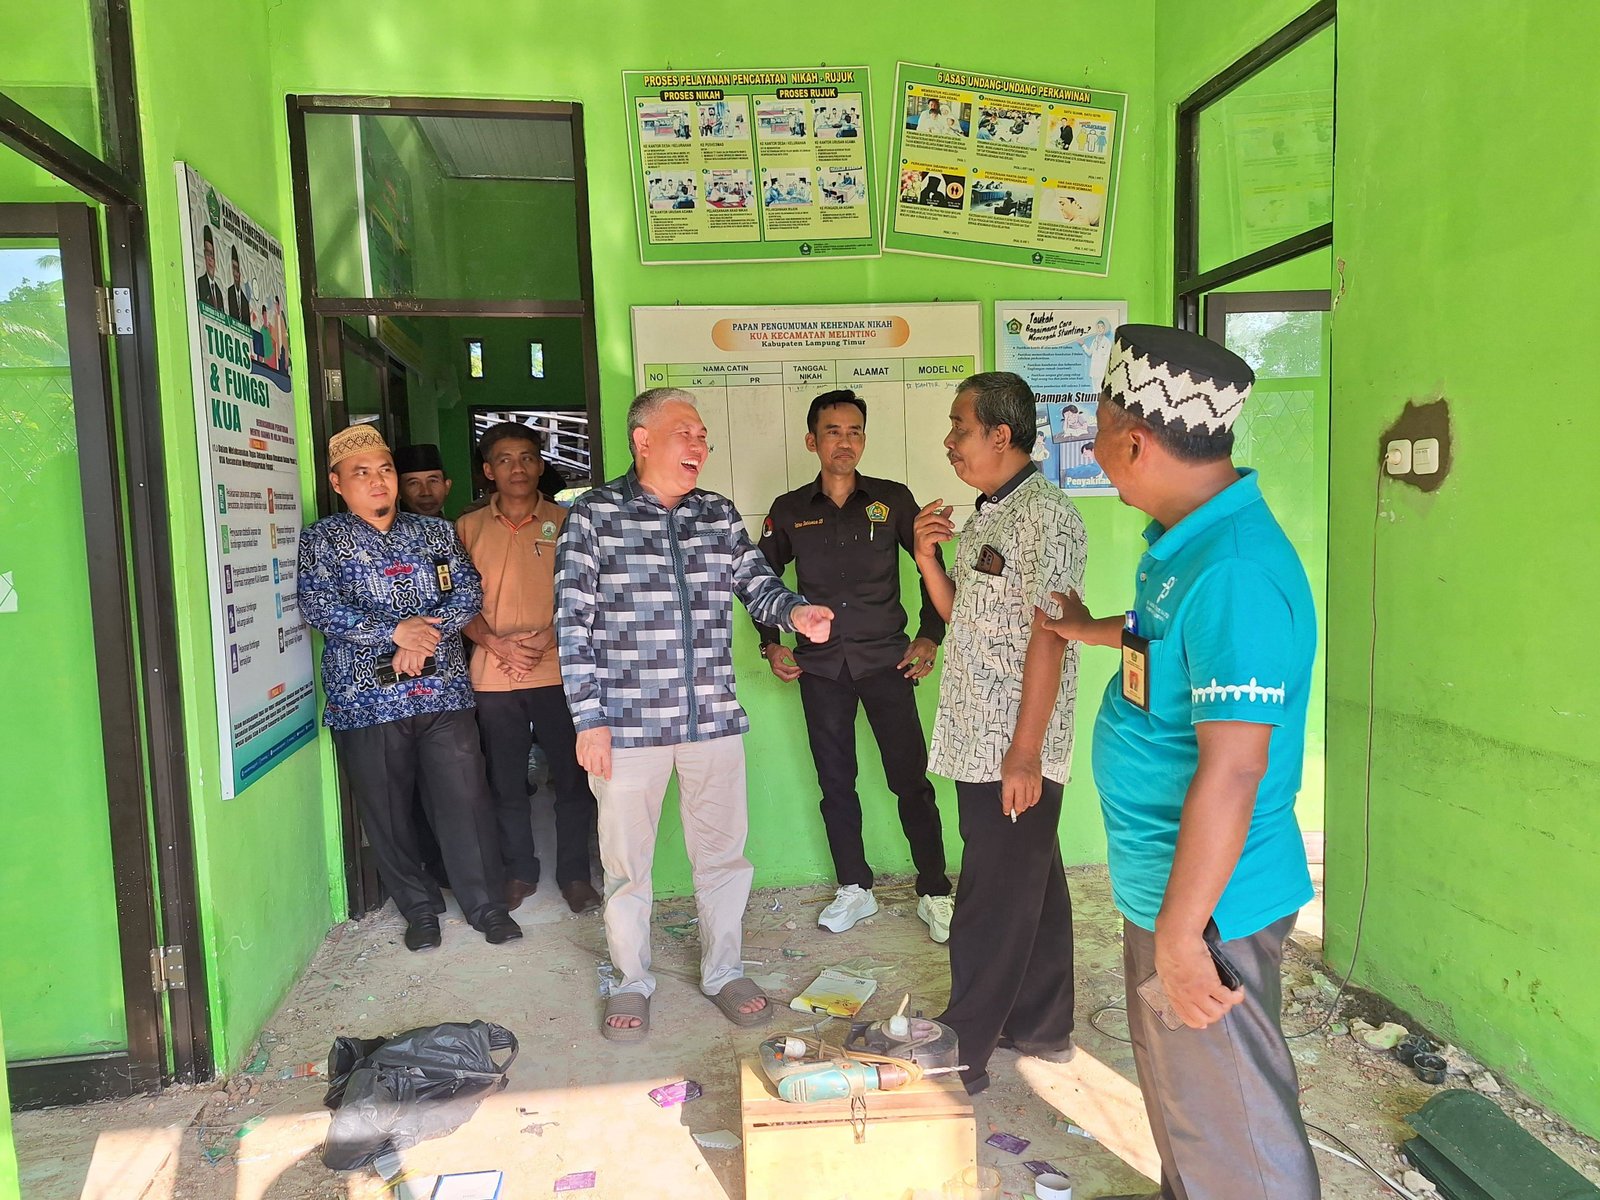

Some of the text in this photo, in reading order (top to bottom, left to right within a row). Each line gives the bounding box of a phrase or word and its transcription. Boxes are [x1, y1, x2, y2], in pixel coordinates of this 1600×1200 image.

[644, 75, 679, 87] PROSES
[680, 74, 731, 86] PELAYANAN
[732, 73, 787, 85] PENCATATAN
[792, 72, 818, 84] NIKAH
[825, 72, 854, 83] RUJUK
[938, 72, 1091, 103] 6 ASAS UNDANG-UNDANG PERKAWINAN
[664, 91, 720, 100] PROSES NIKAH
[780, 88, 836, 98] PROSES RUJUK
[1026, 324, 1058, 334] Bagaimana
[771, 331, 826, 339] KECAMATAN
[829, 330, 876, 338] MELINTING
[1028, 332, 1056, 341] Mencegah
[205, 324, 251, 370] TUGAS
[761, 340, 803, 348] Kabupaten
[853, 368, 889, 376] ALAMAT
[919, 365, 949, 374] MODEL
[650, 373, 664, 381] NO
[210, 362, 270, 408] & FUNGSI
[1035, 392, 1072, 403] Dampak
[211, 398, 242, 433] KUA
